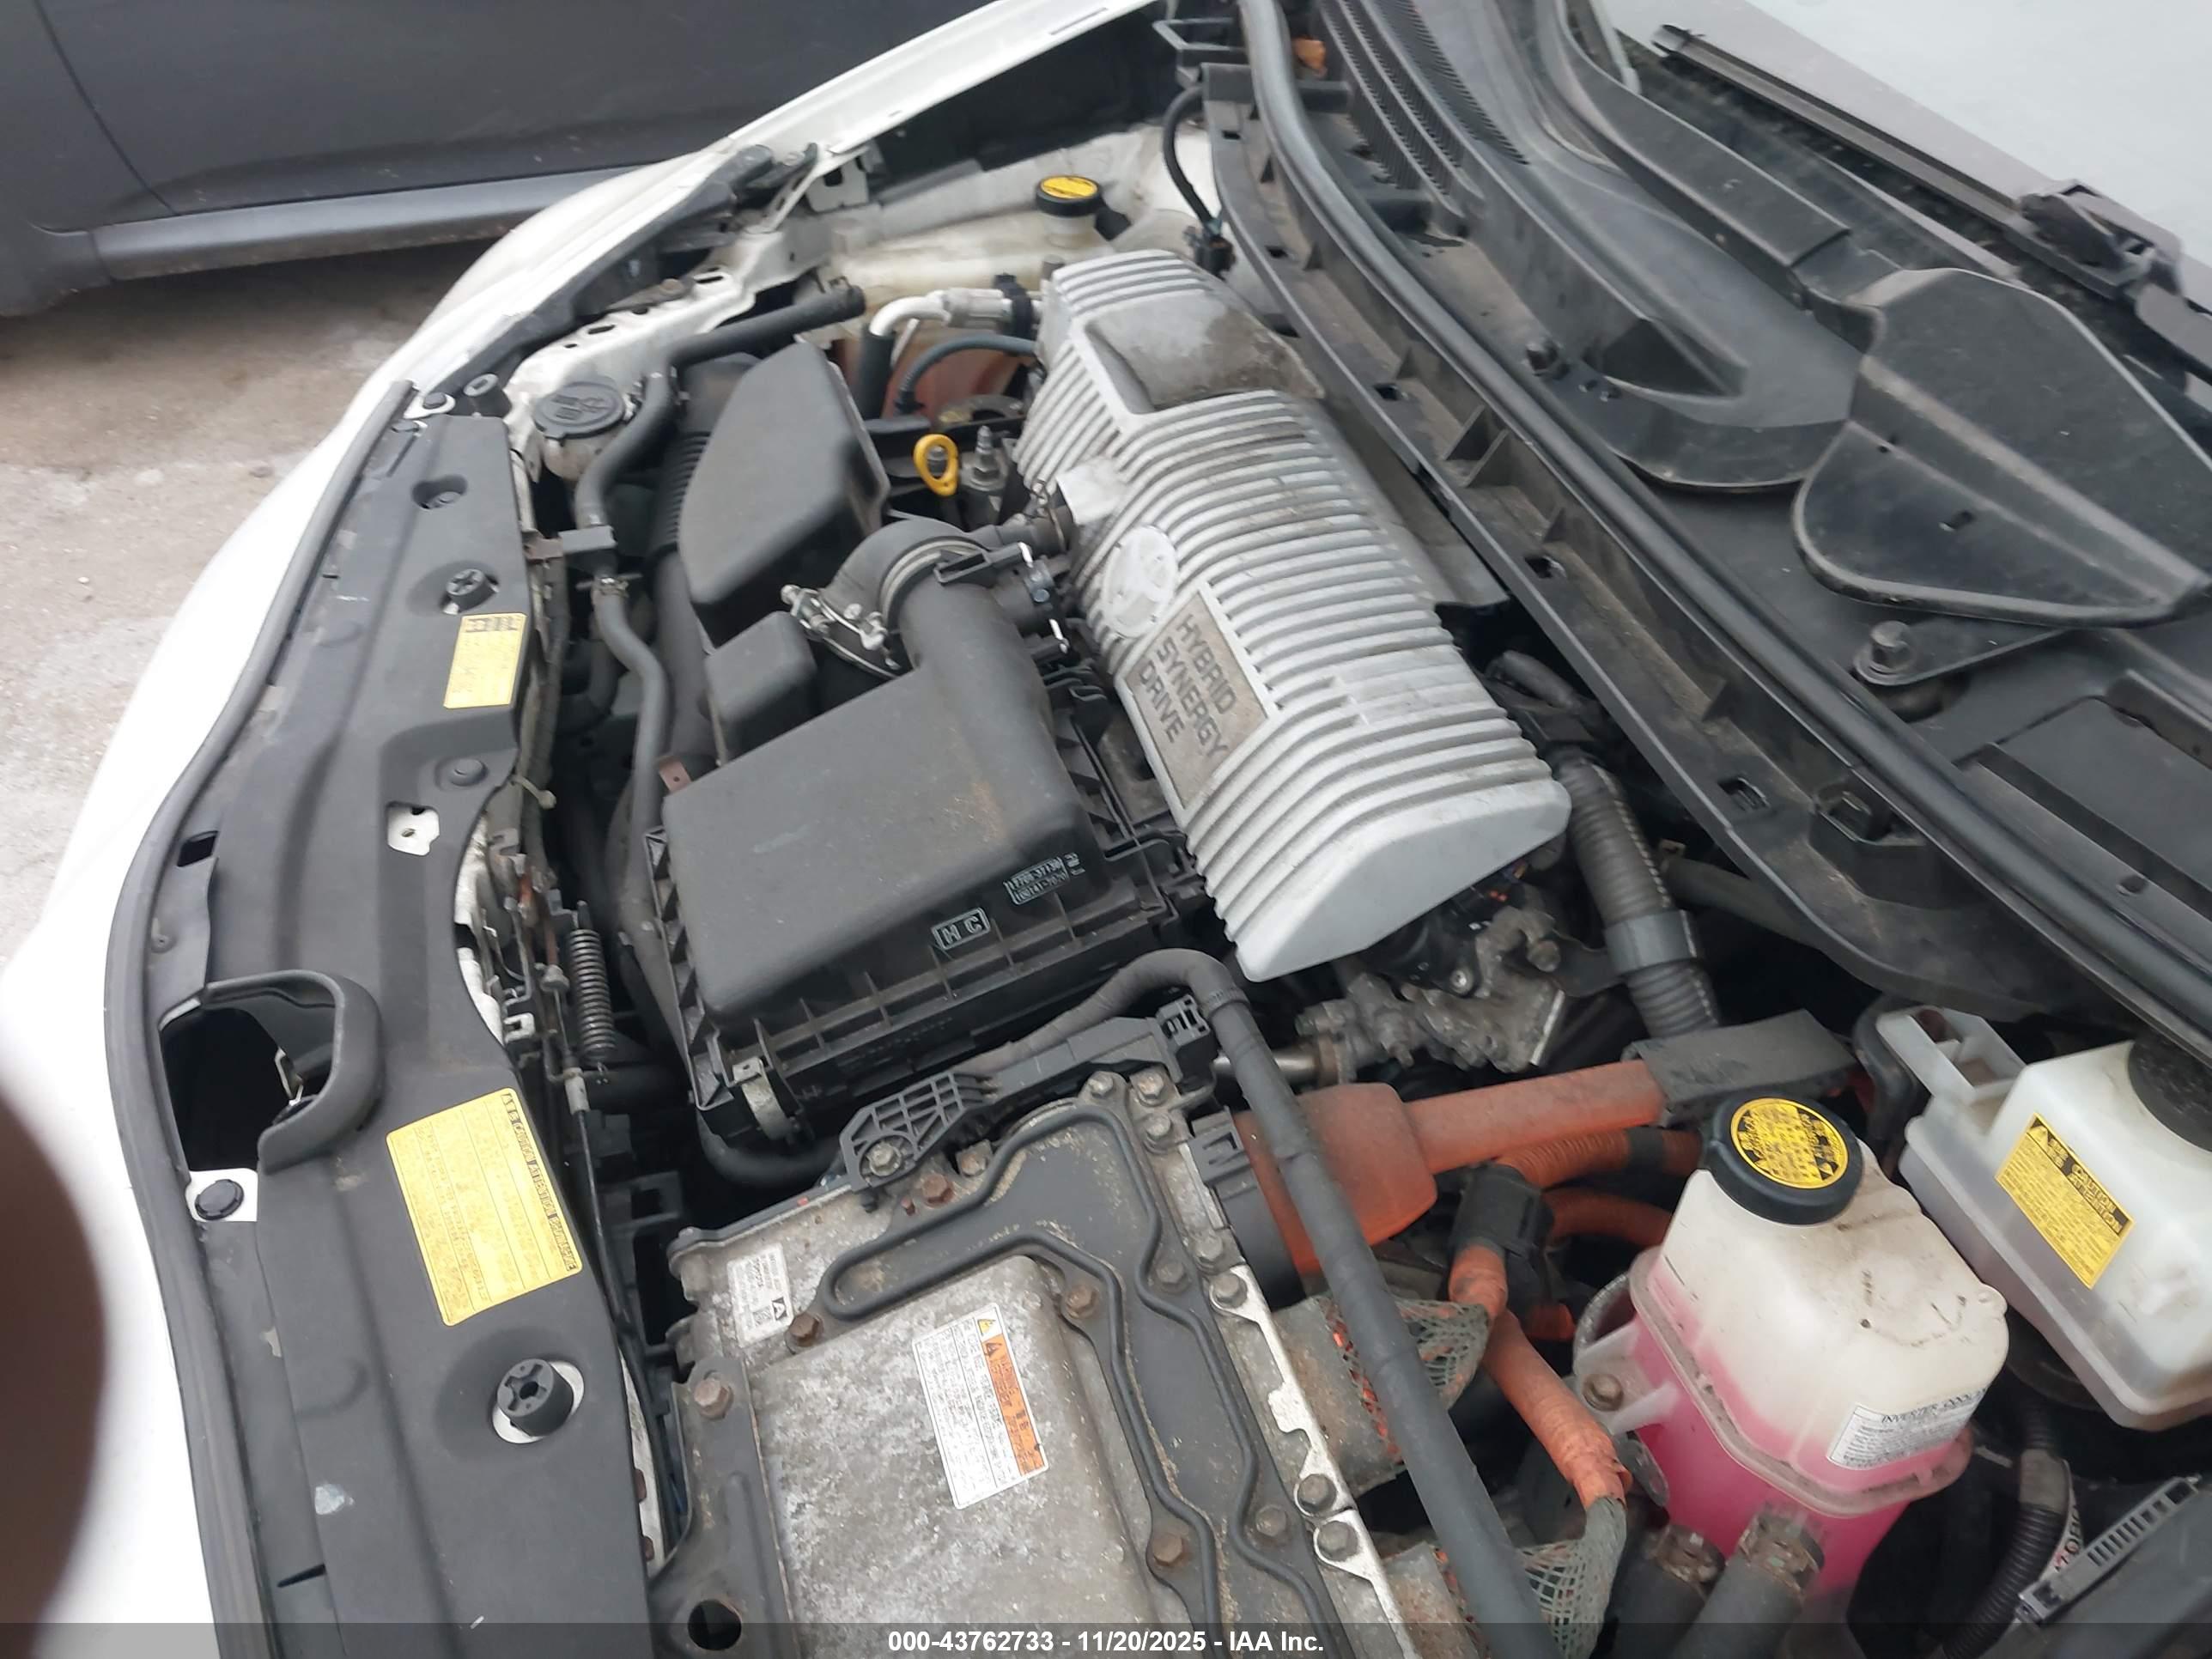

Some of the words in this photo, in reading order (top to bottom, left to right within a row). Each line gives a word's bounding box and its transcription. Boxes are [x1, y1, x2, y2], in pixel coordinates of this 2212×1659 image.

[1139, 660, 1184, 743] DRIVE
[1157, 636, 1229, 757] SYNERGY
[1176, 614, 1237, 714] HYBRID
[2067, 1171, 2123, 1233] ATTENTION
[2071, 1163, 2117, 1214] CAUTION
